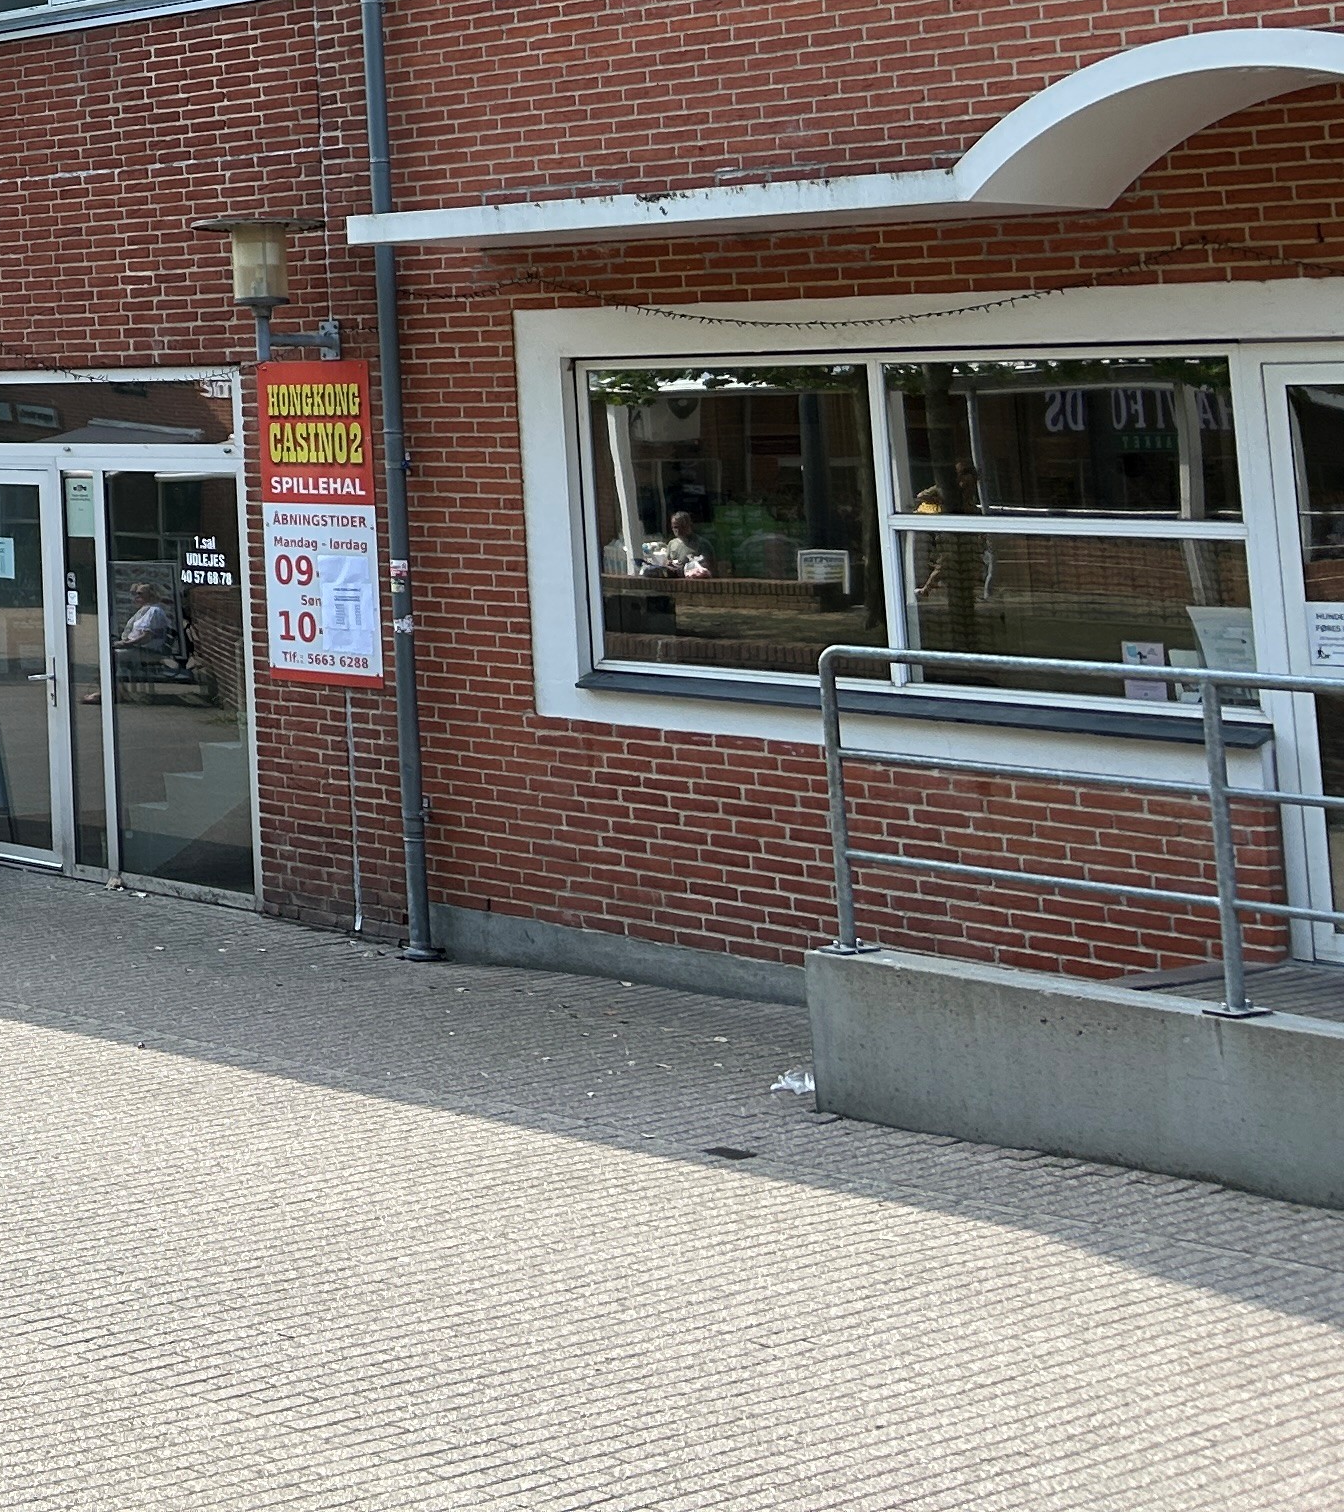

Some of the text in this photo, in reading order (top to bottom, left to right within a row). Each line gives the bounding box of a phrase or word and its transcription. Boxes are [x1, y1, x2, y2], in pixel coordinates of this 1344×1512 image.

[267, 383, 360, 416] HONGKONG
[271, 476, 366, 496] SPILLEHAL
[272, 510, 367, 528] ÅBNINGSTIDER
[273, 536, 318, 551] Mandag
[329, 537, 368, 553] lørdag
[186, 553, 226, 568] UDLEJES
[181, 570, 192, 583] 40
[194, 570, 205, 584] 57
[301, 595, 322, 606] Søn
[307, 654, 336, 666] 5663
[340, 656, 369, 669] 6288
